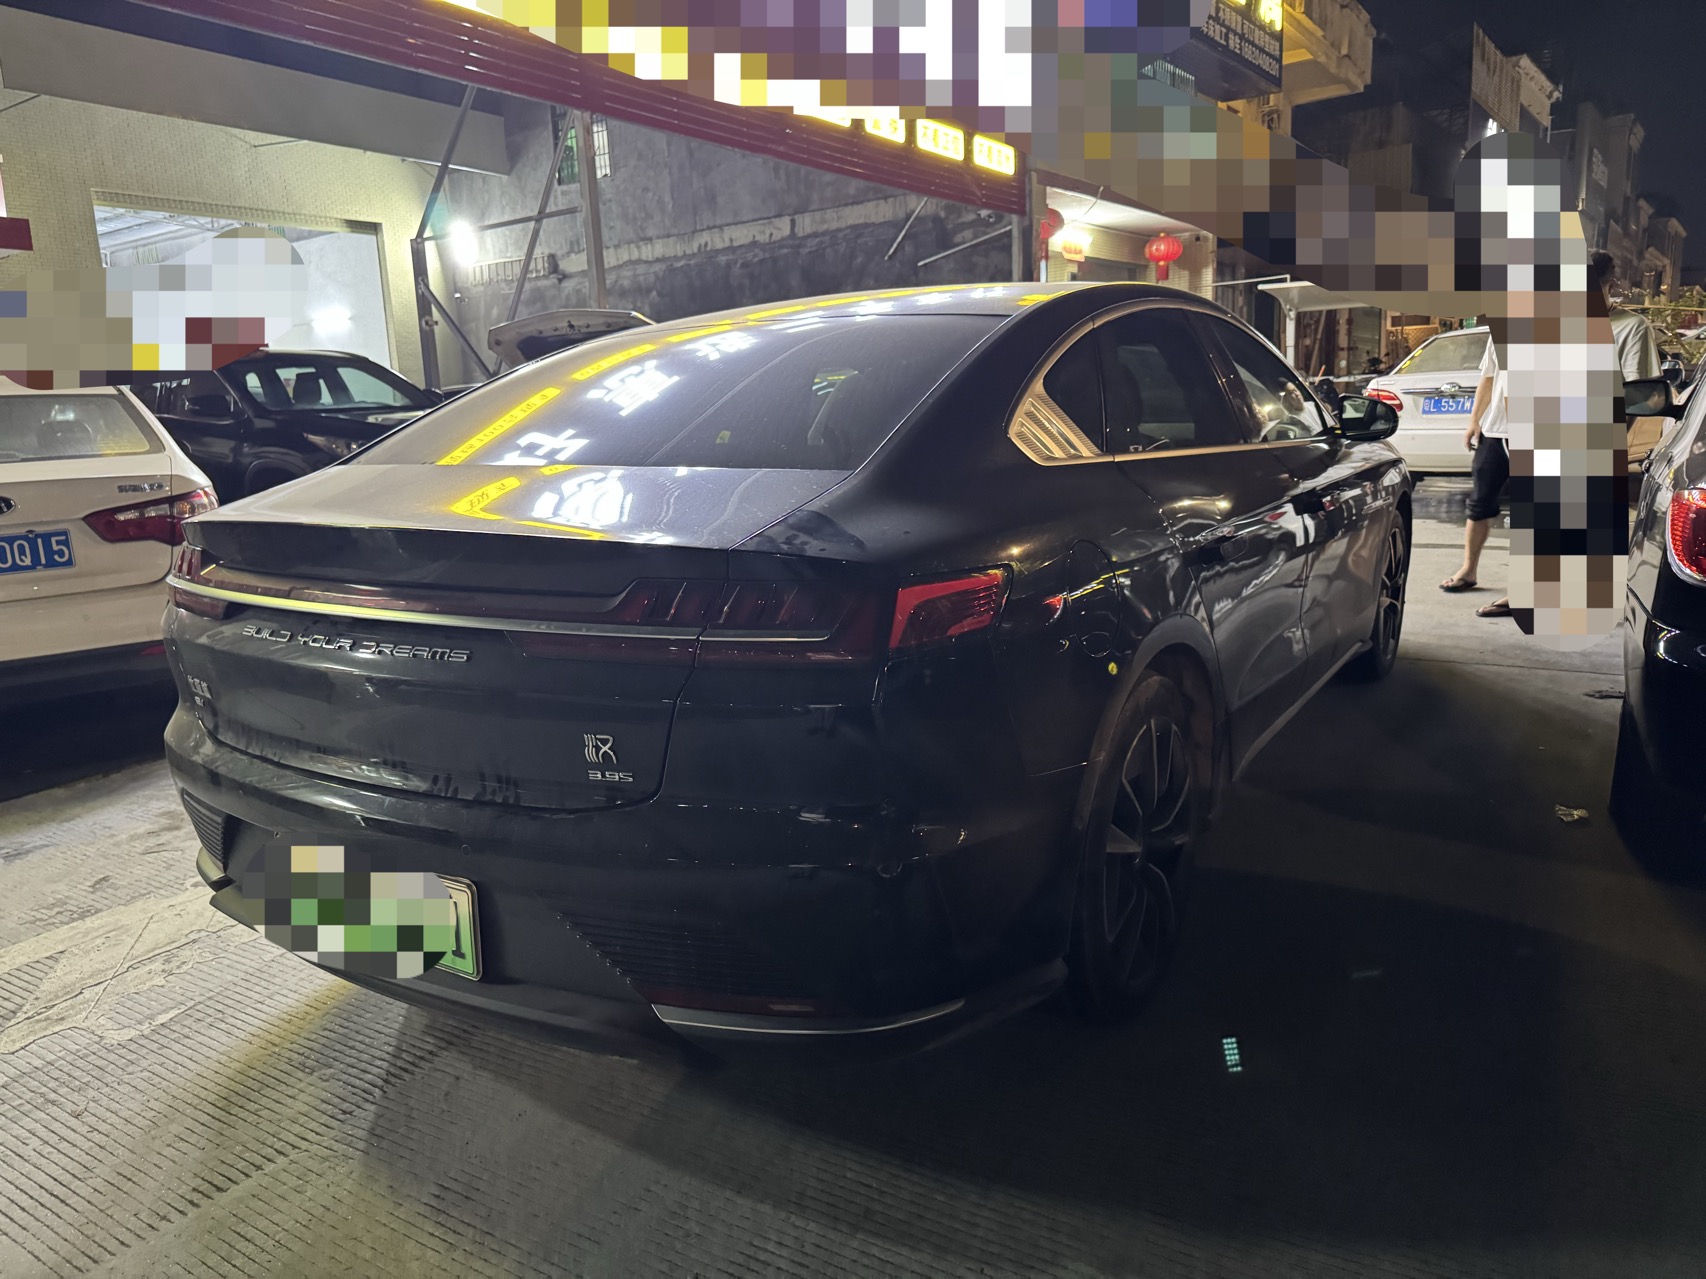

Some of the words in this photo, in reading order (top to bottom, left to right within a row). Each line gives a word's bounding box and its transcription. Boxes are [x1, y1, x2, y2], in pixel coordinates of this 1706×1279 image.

[242, 624, 292, 642] BUILD
[298, 633, 354, 652] YOUR
[359, 641, 472, 662] DREAMS
